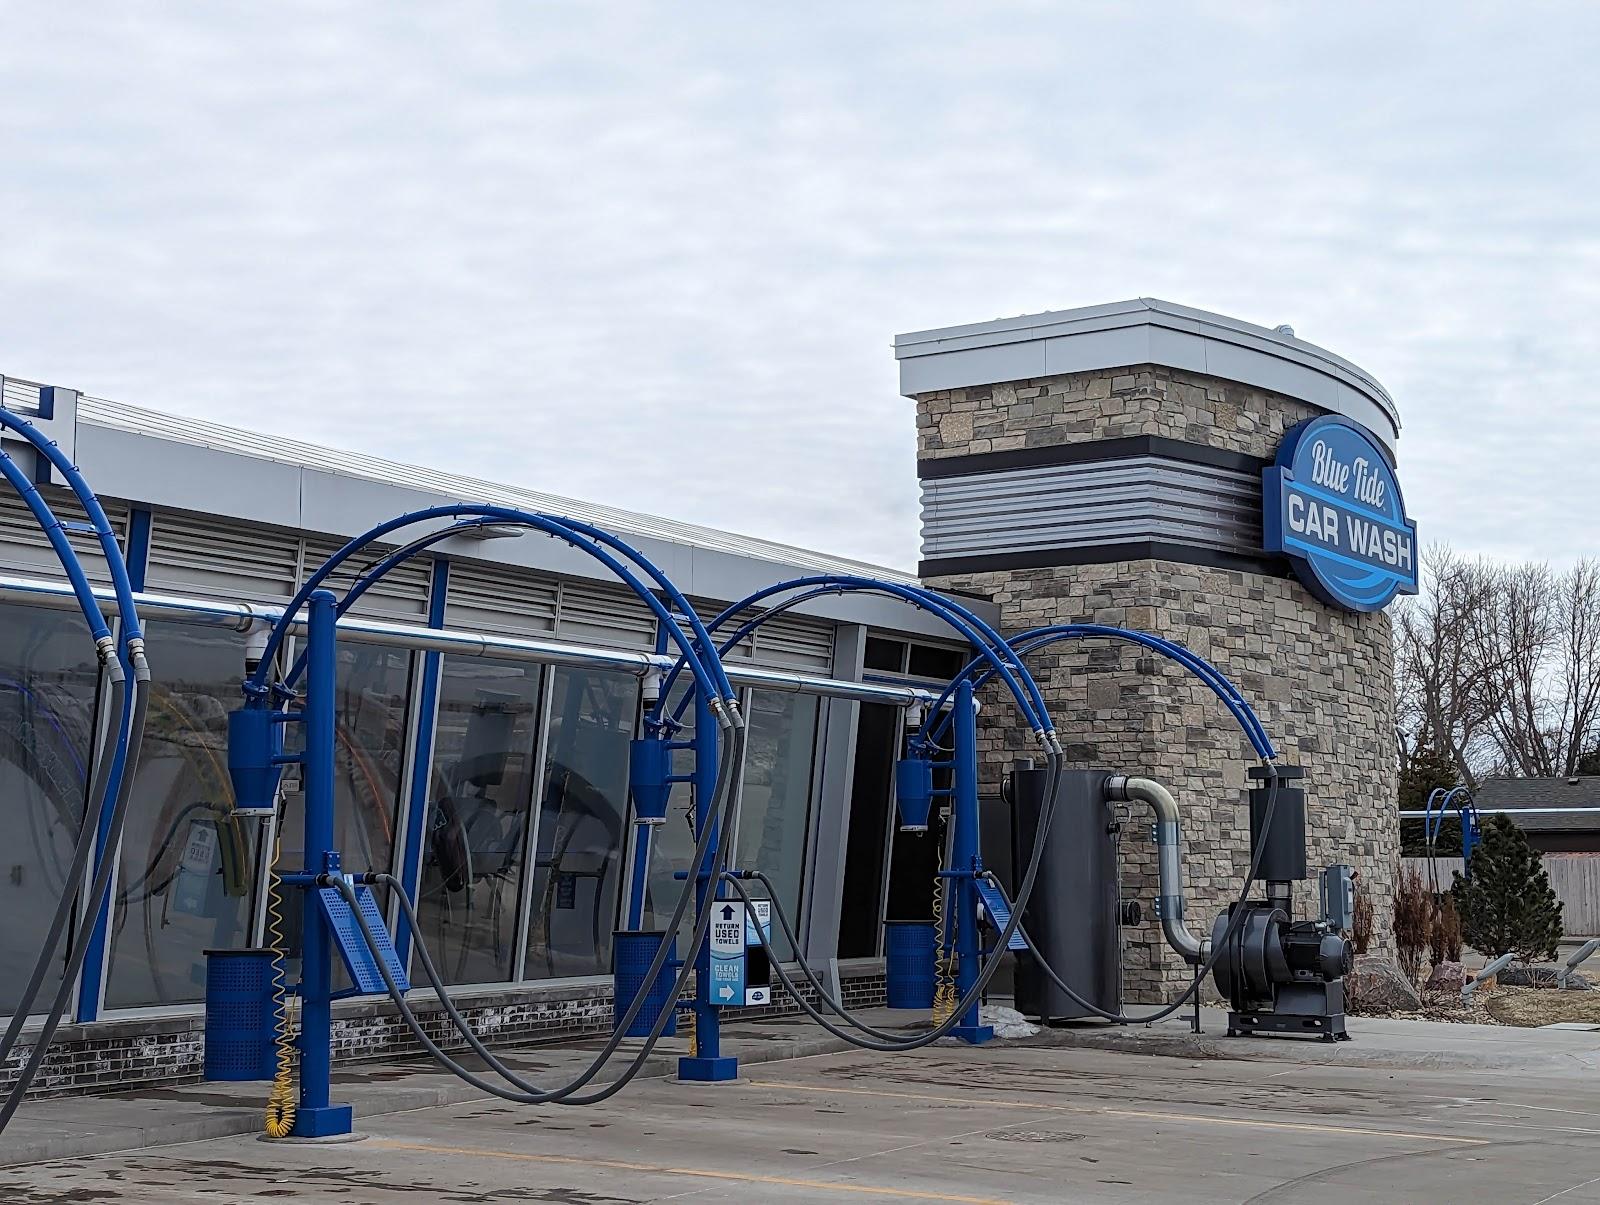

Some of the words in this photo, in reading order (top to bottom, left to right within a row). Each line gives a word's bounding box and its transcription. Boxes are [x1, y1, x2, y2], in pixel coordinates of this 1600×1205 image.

[1312, 440, 1349, 493] Blue
[1353, 456, 1385, 509] Tide
[1288, 494, 1339, 546] CAR
[1346, 516, 1412, 571] WASH
[715, 929, 739, 938] USED
